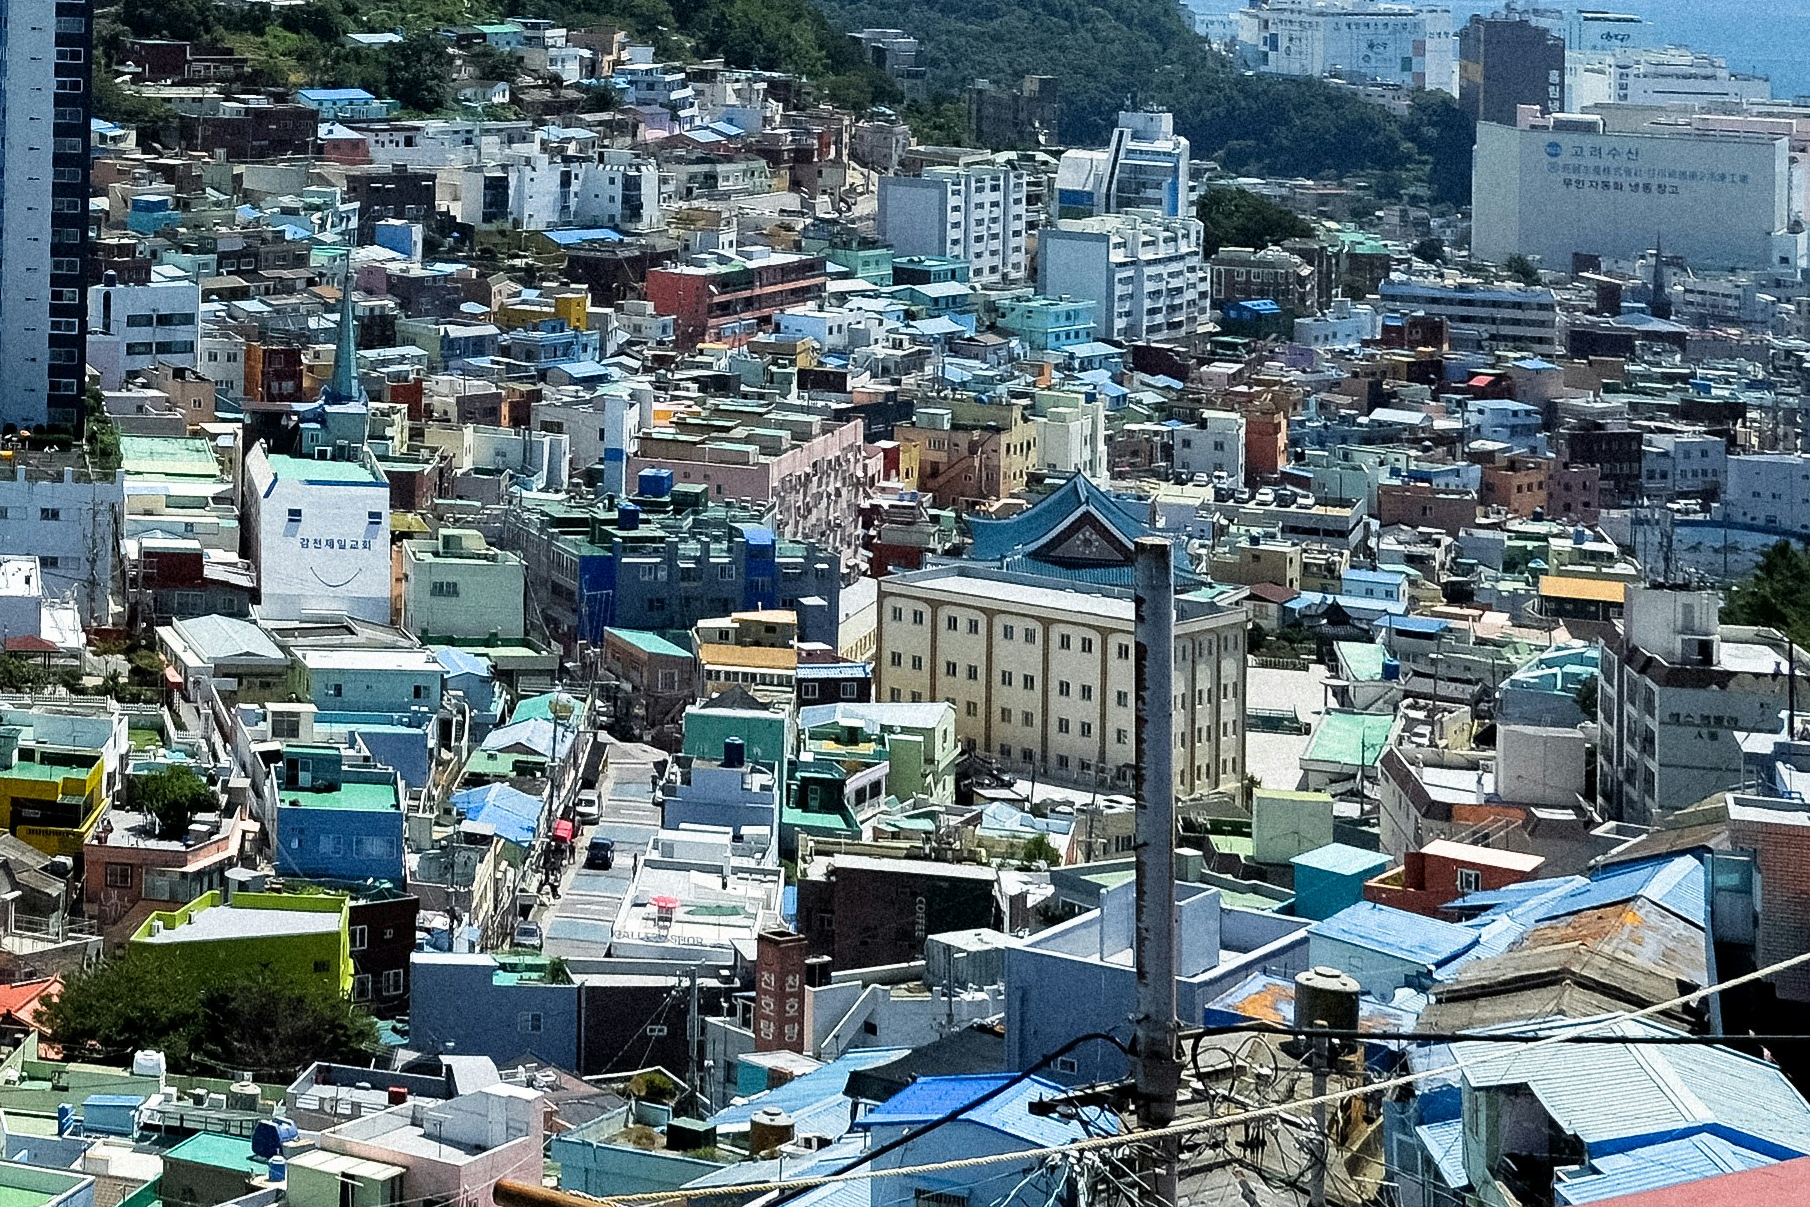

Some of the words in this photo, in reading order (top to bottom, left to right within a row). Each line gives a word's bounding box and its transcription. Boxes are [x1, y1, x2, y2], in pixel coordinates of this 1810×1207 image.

[299, 537, 372, 551] 감천제일교회
[915, 896, 926, 937] COFFEE
[760, 970, 776, 1041] 천호탕
[785, 973, 800, 1043] 천호탕
